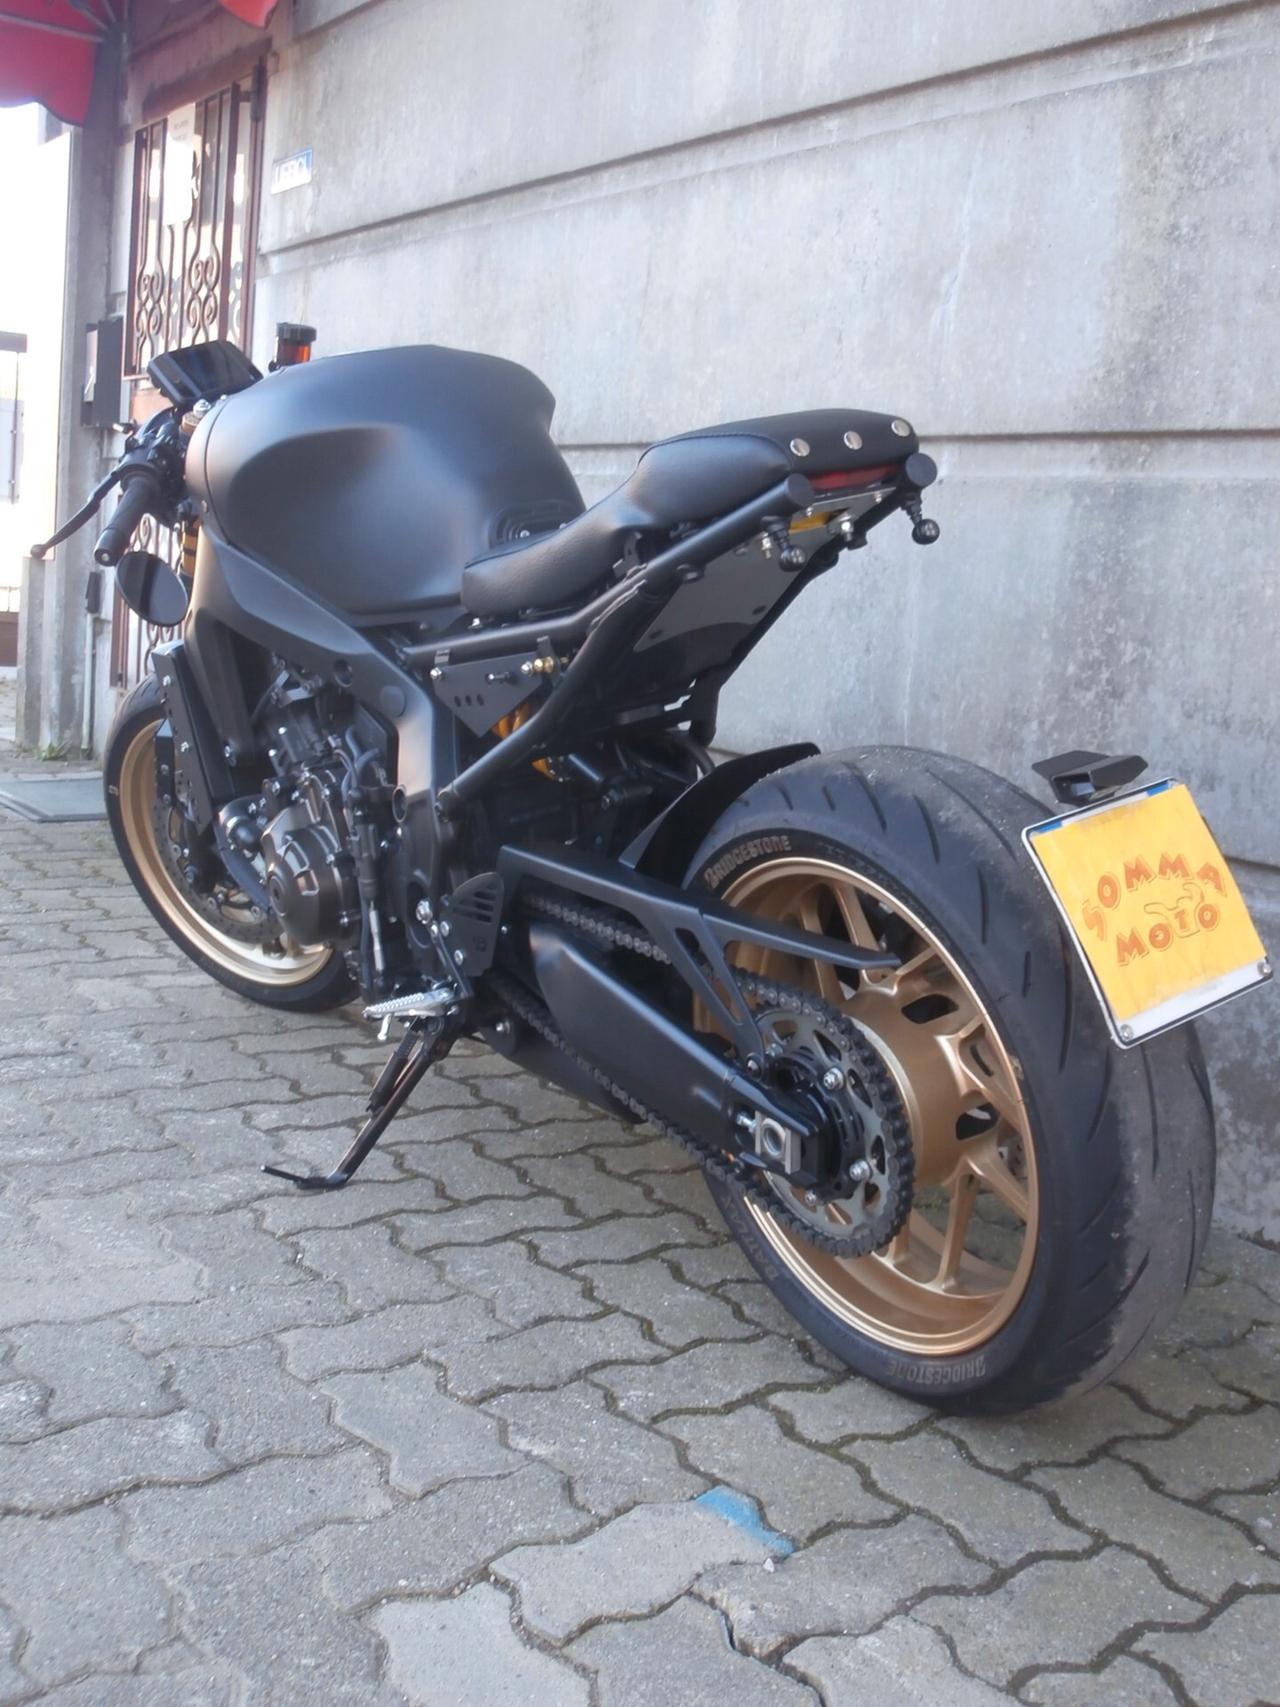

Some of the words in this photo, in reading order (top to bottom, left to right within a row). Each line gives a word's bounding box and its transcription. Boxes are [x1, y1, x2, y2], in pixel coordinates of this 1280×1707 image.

[703, 835, 791, 889] BRIDGESTONE
[1082, 852, 1227, 942] SOMMA
[1116, 903, 1220, 967] MOTO
[886, 1354, 986, 1385] BRIDGESTONE
